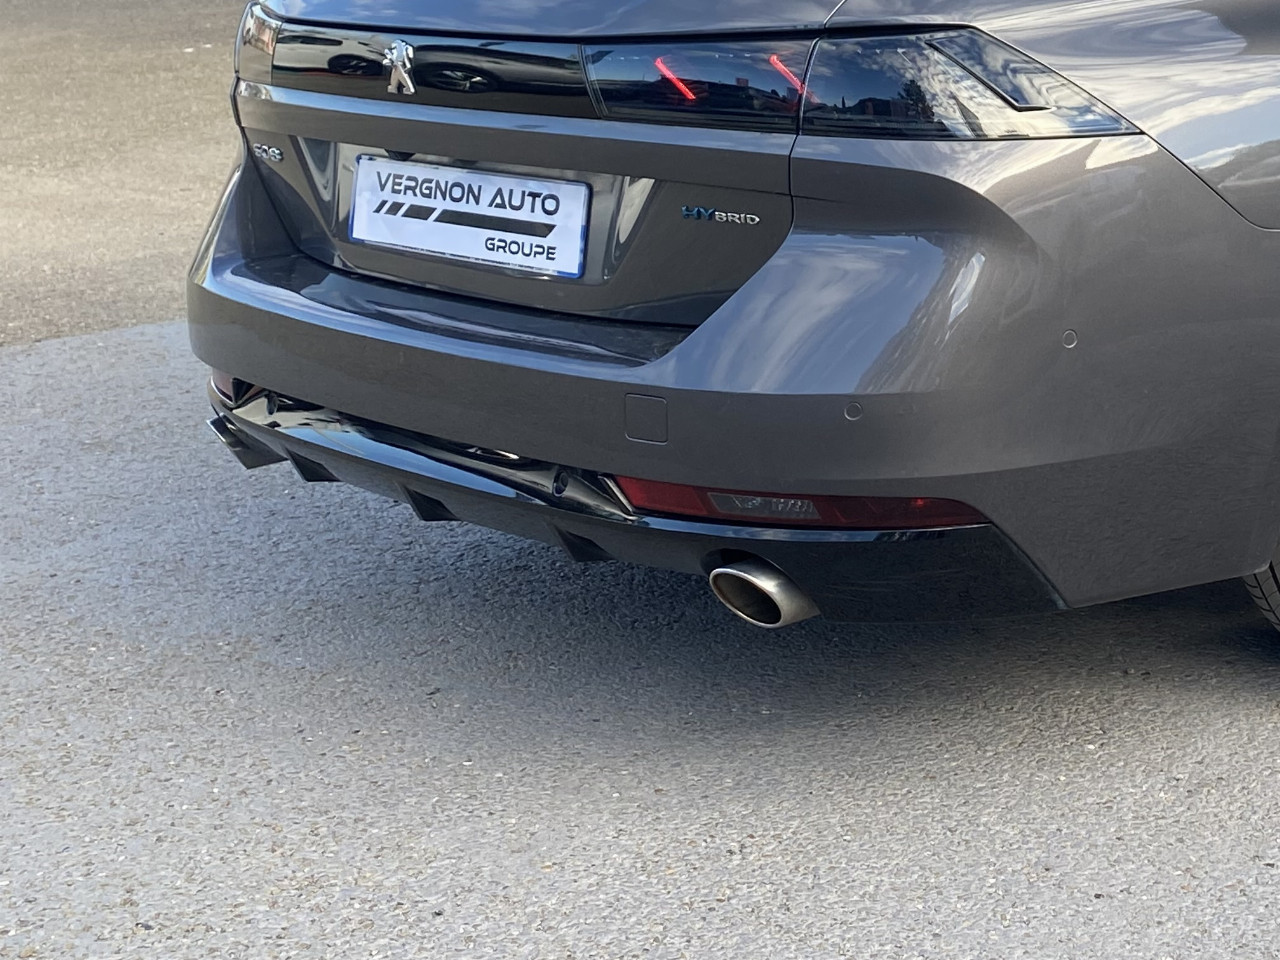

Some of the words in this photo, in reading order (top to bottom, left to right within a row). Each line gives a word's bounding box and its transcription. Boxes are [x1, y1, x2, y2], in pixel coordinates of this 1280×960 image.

[376, 171, 483, 208] VERGNON
[487, 186, 560, 216] AUTO
[681, 205, 760, 225] HYBRID
[484, 237, 557, 261] GROUPE
